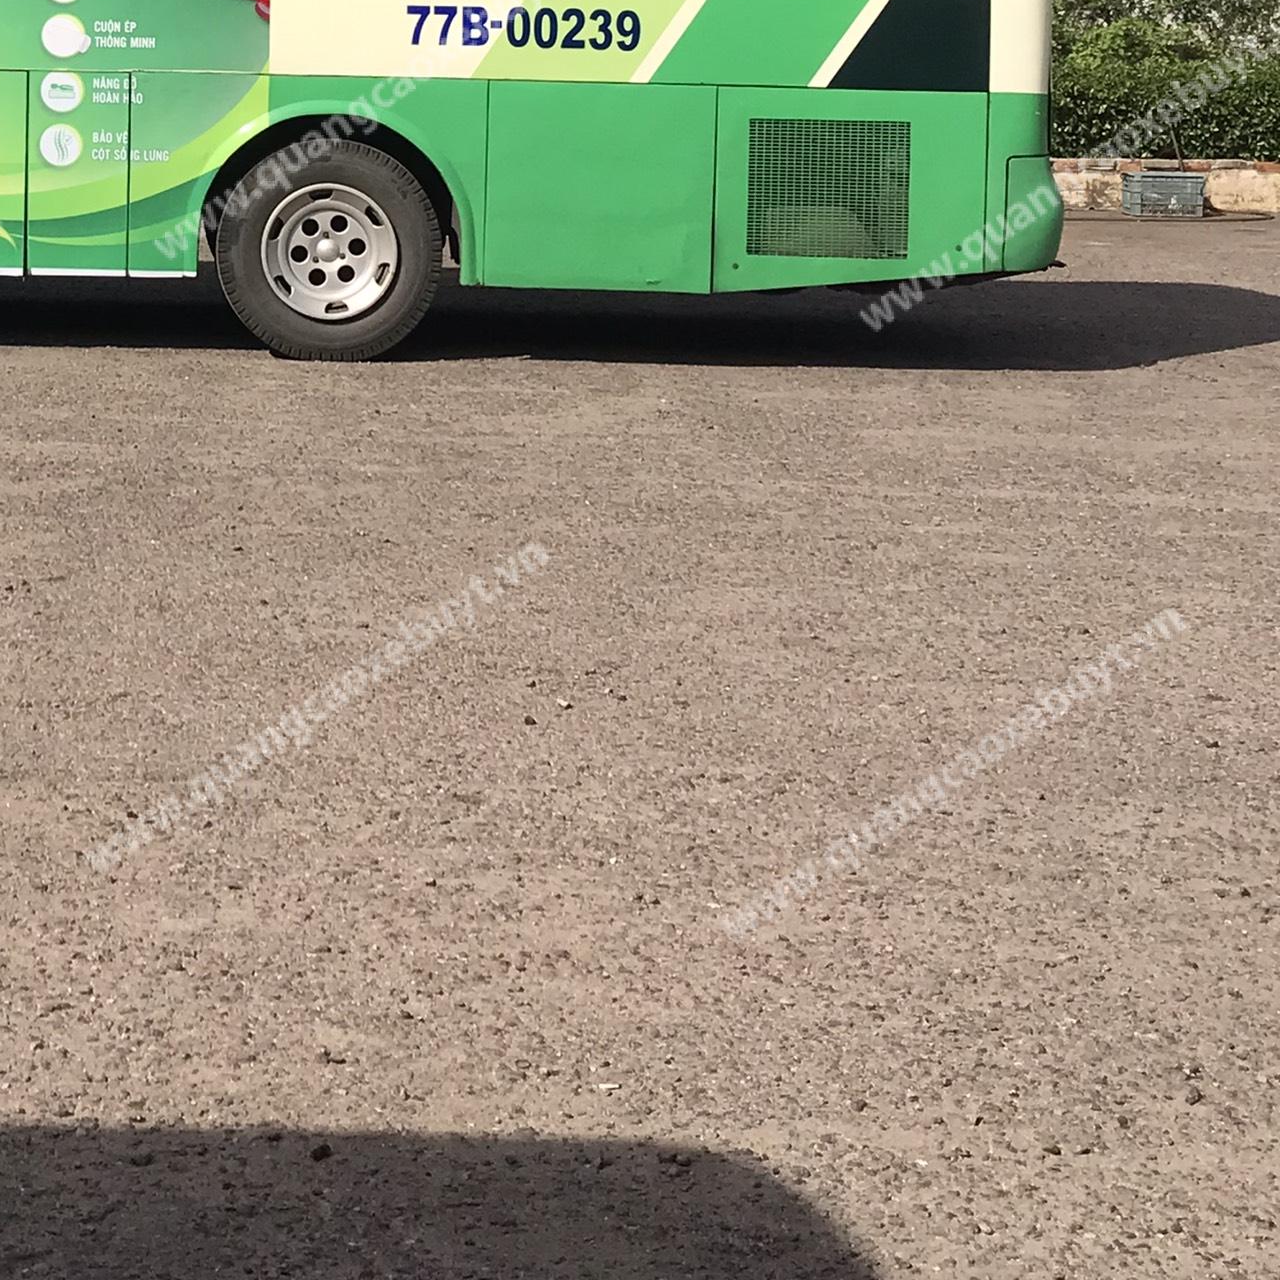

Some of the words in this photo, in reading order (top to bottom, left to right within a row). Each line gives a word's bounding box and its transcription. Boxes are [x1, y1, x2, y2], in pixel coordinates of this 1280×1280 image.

[94, 20, 121, 34] CUỘN
[124, 20, 137, 32] ÉP
[407, 5, 641, 52] 77B-00239
[94, 35, 127, 48] THÔNG
[130, 37, 156, 49] MINH
